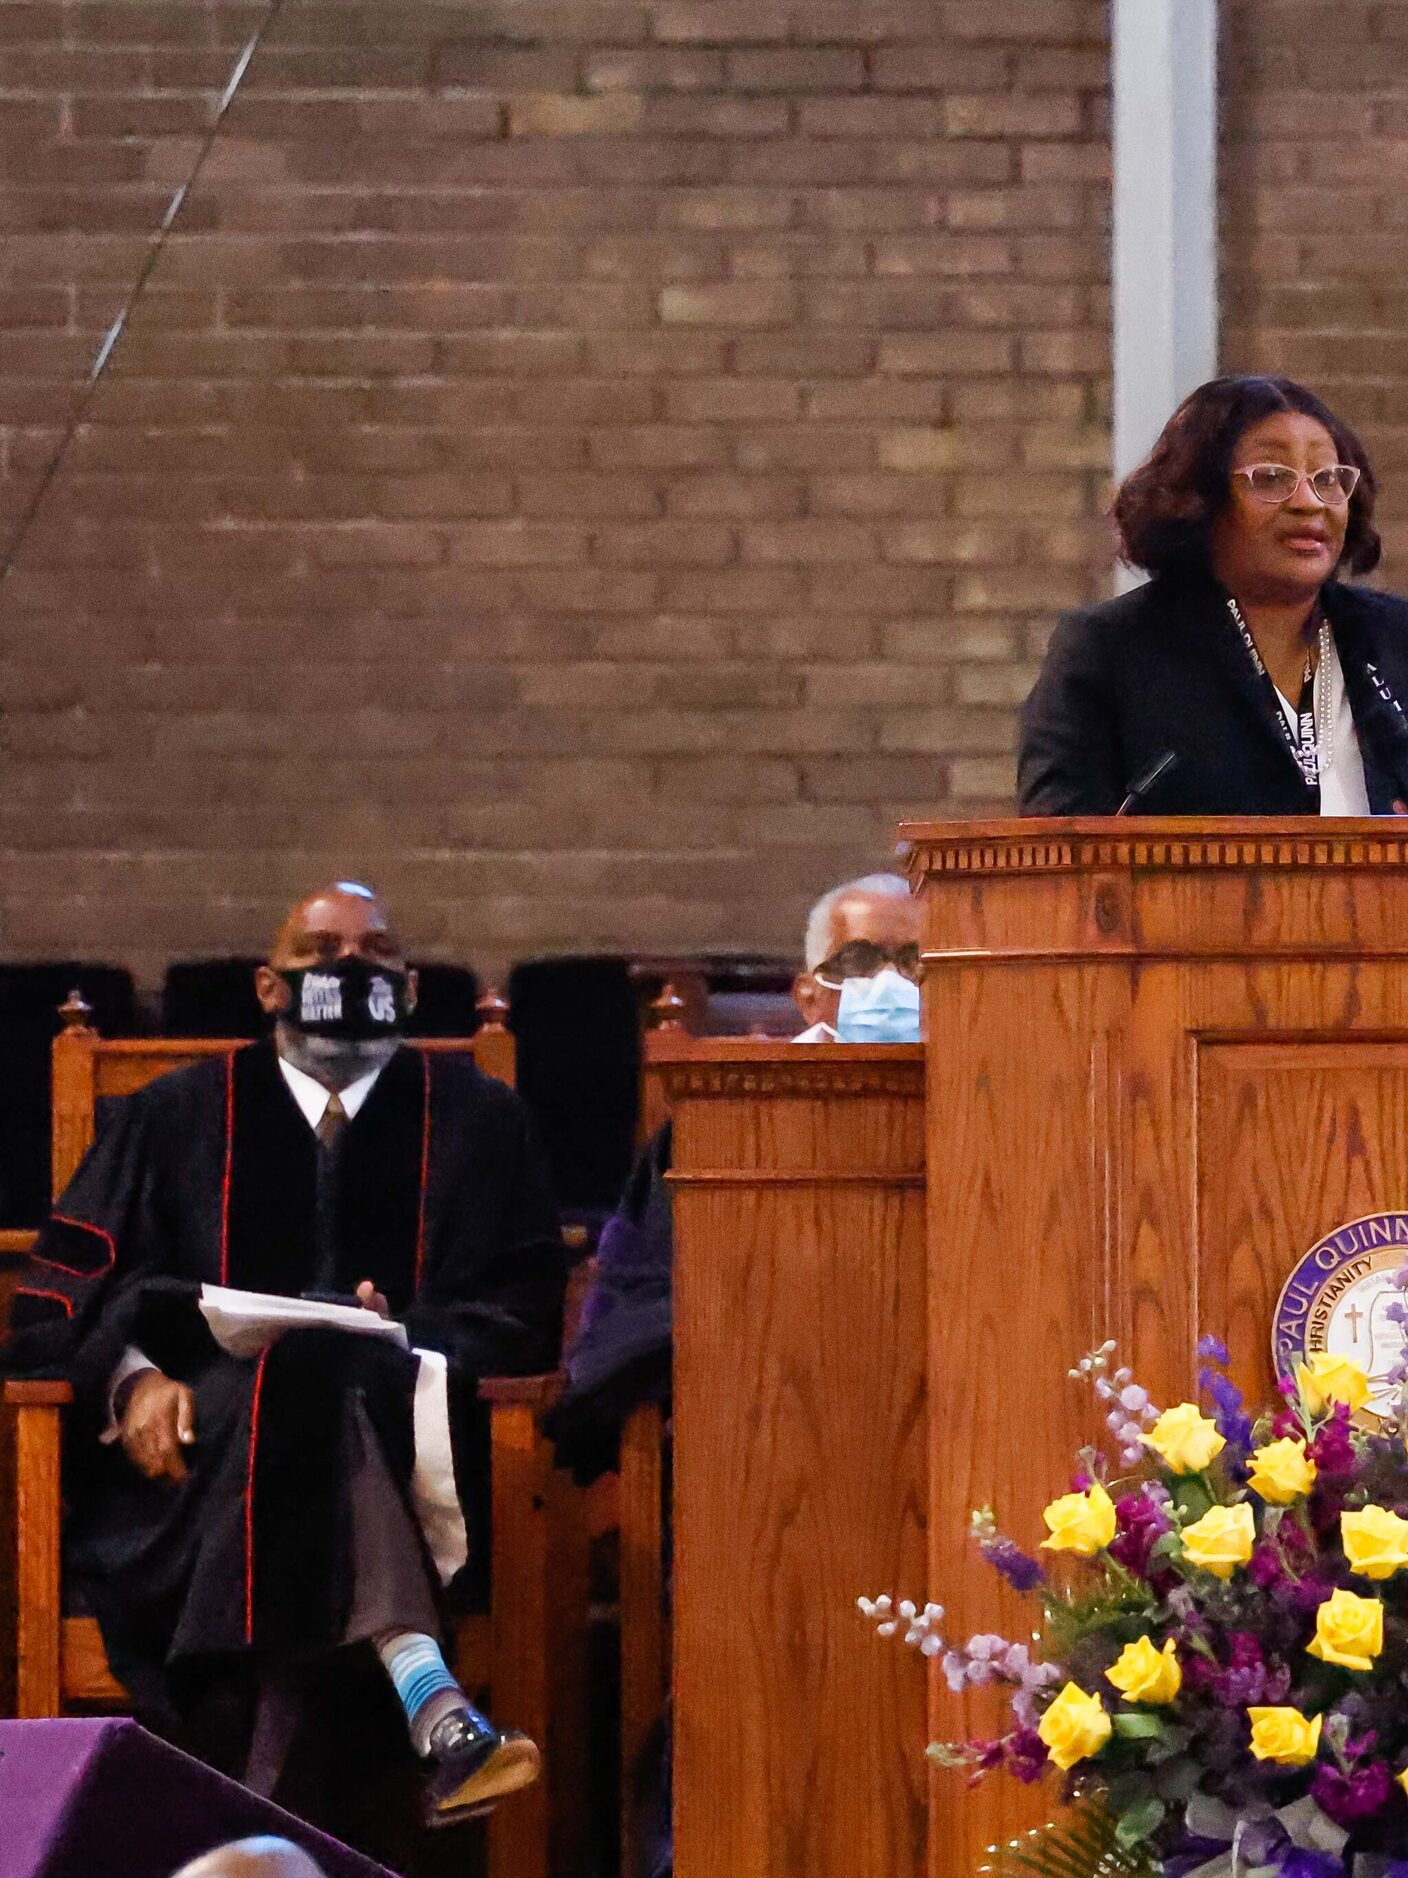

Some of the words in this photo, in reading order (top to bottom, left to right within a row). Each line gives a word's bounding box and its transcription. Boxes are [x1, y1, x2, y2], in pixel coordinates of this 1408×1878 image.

[1300, 712, 1316, 757] QUINN
[1279, 1281, 1319, 1353] PAUL
[1309, 1256, 1372, 1353] HRISTIANITY
